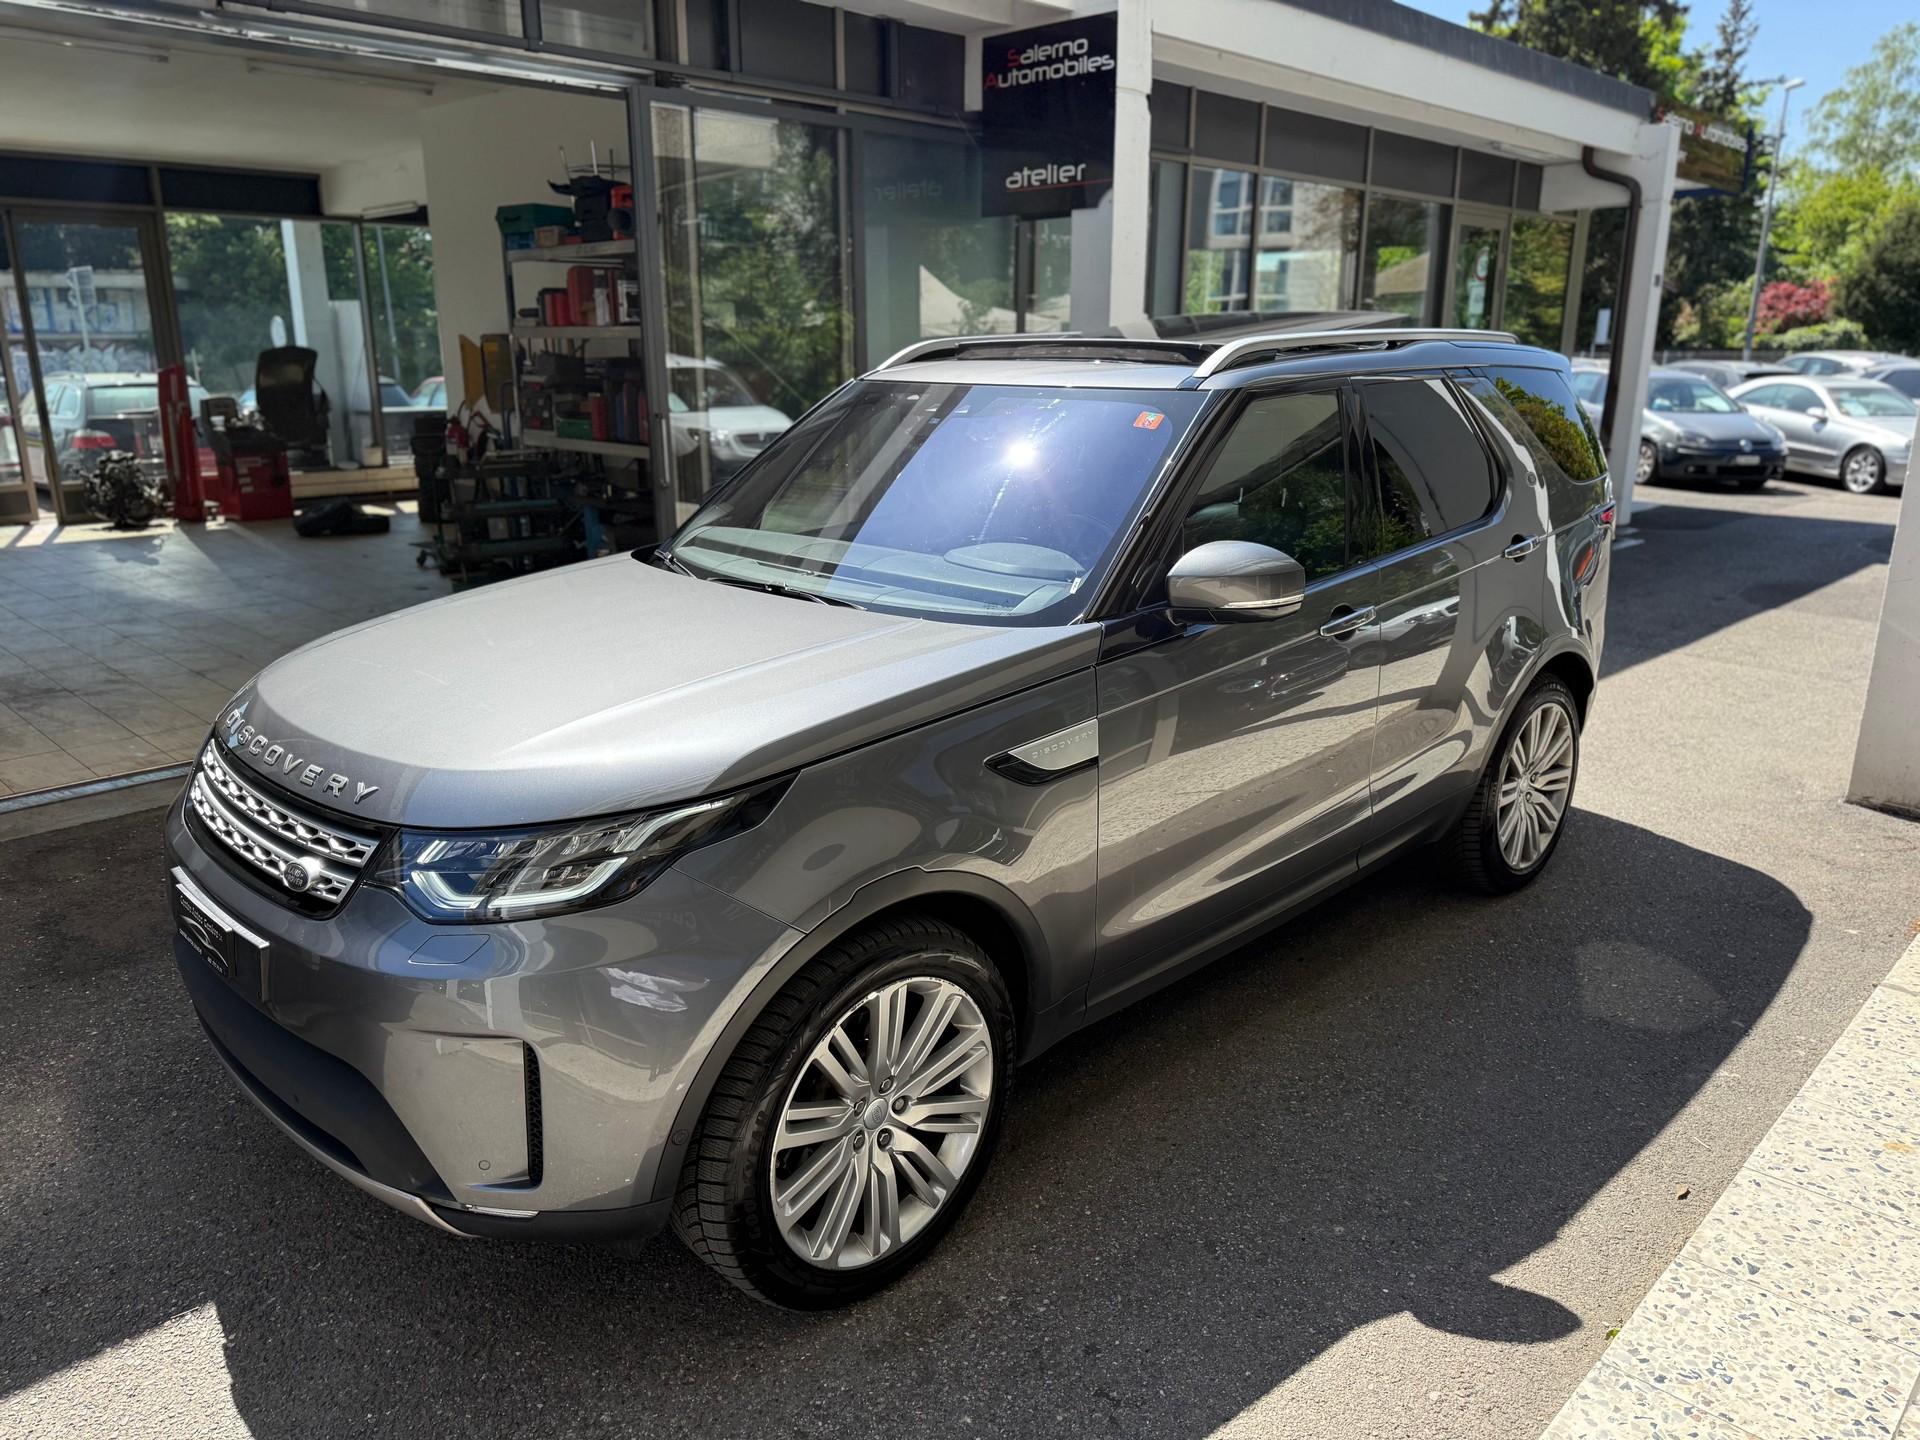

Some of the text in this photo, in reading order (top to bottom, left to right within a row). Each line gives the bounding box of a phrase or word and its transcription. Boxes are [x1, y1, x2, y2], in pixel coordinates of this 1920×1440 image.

[1007, 38, 1089, 68] Salerno
[983, 54, 1116, 90] Automobiles
[1005, 163, 1087, 189] atelier
[225, 708, 380, 804] DISCOVERY
[1031, 729, 1094, 759] DISCOVERY
